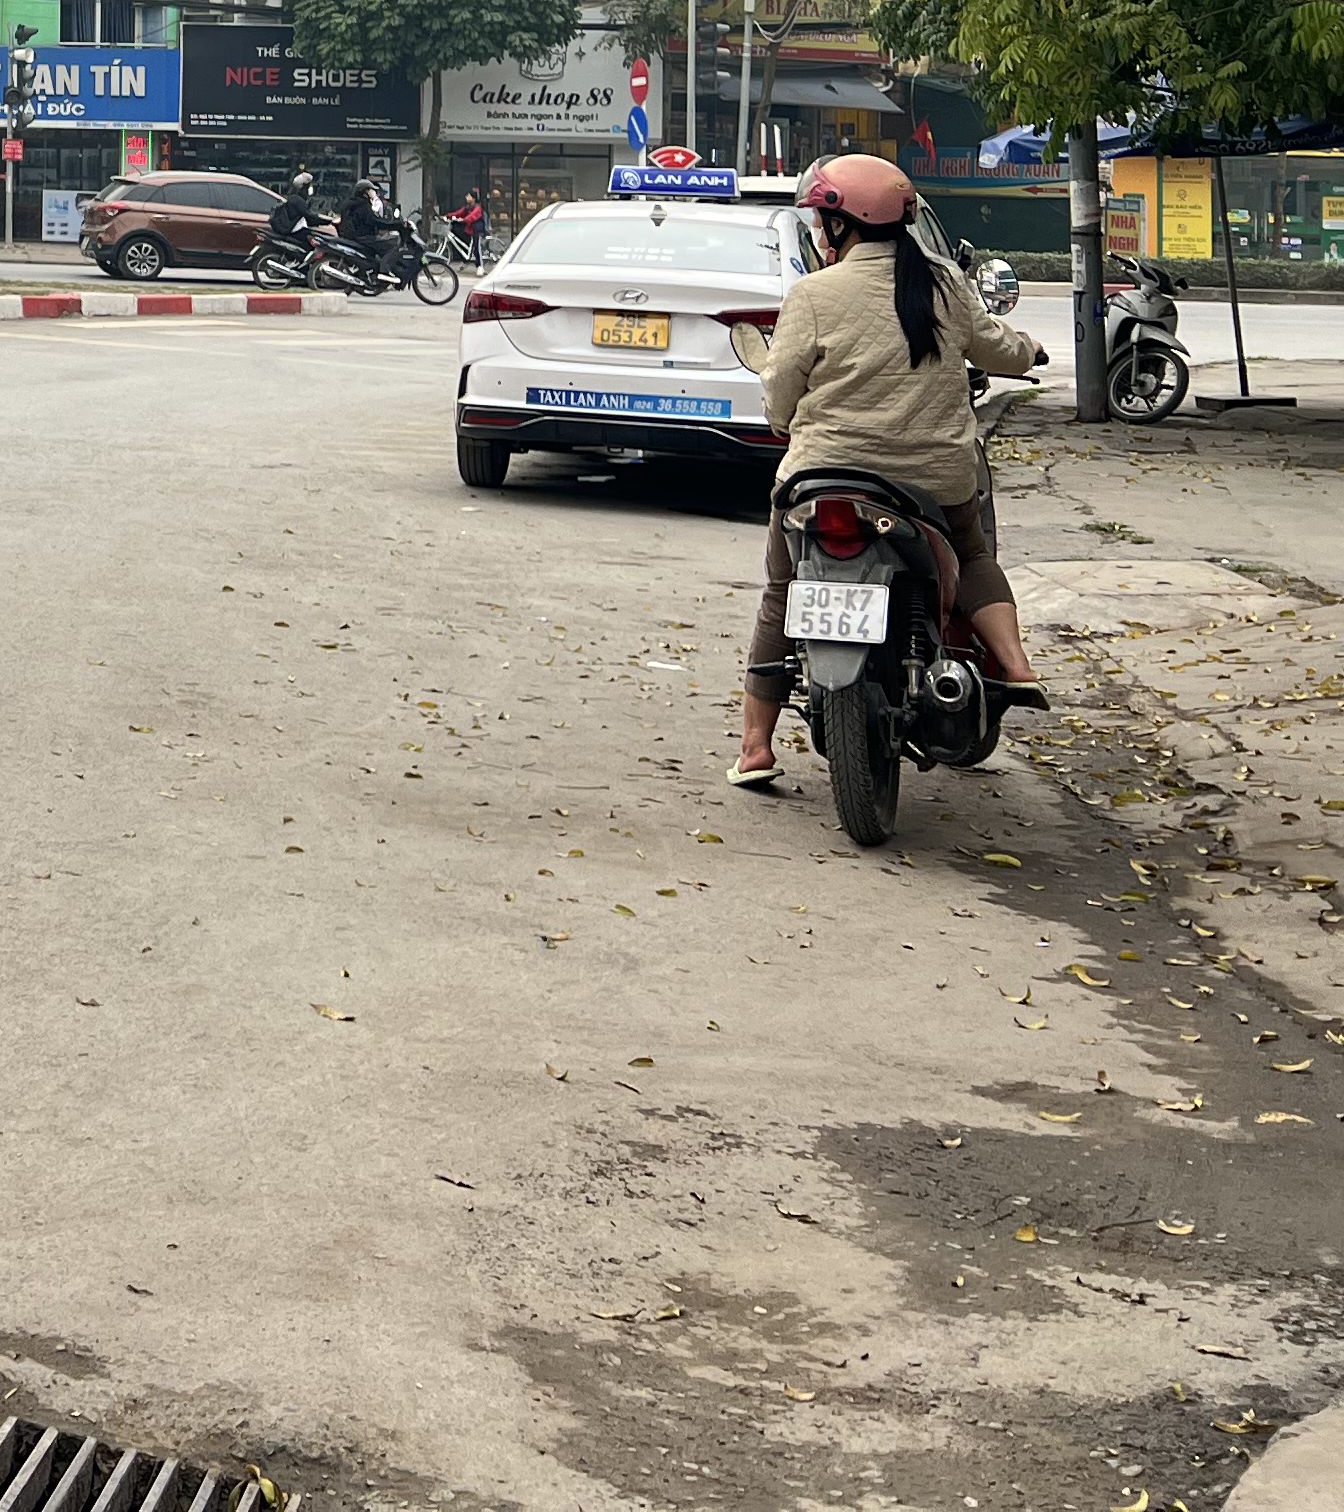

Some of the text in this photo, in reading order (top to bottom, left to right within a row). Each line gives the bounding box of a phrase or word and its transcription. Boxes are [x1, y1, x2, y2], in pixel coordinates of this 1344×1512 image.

[256, 43, 280, 58] THẾ
[90, 58, 147, 98] TÍN
[226, 67, 378, 89] NICE SHOES
[266, 94, 283, 105] BÁN
[470, 83, 614, 110] Cake shop 88
[47, 99, 86, 116] ĐỨC
[487, 110, 509, 119] Bánh
[530, 113, 554, 122] ngon
[573, 112, 594, 123] ngọt
[940, 152, 971, 177] NGHỈ
[644, 174, 728, 187] LAN ANH
[1111, 213, 1136, 230] NHÀ
[615, 315, 647, 329] 29E
[600, 328, 659, 346] 053.41
[538, 389, 722, 415] TAXI LAN ANH (024) 36.558.558
[803, 586, 874, 612] 30-K7
[801, 611, 870, 638] 5564
